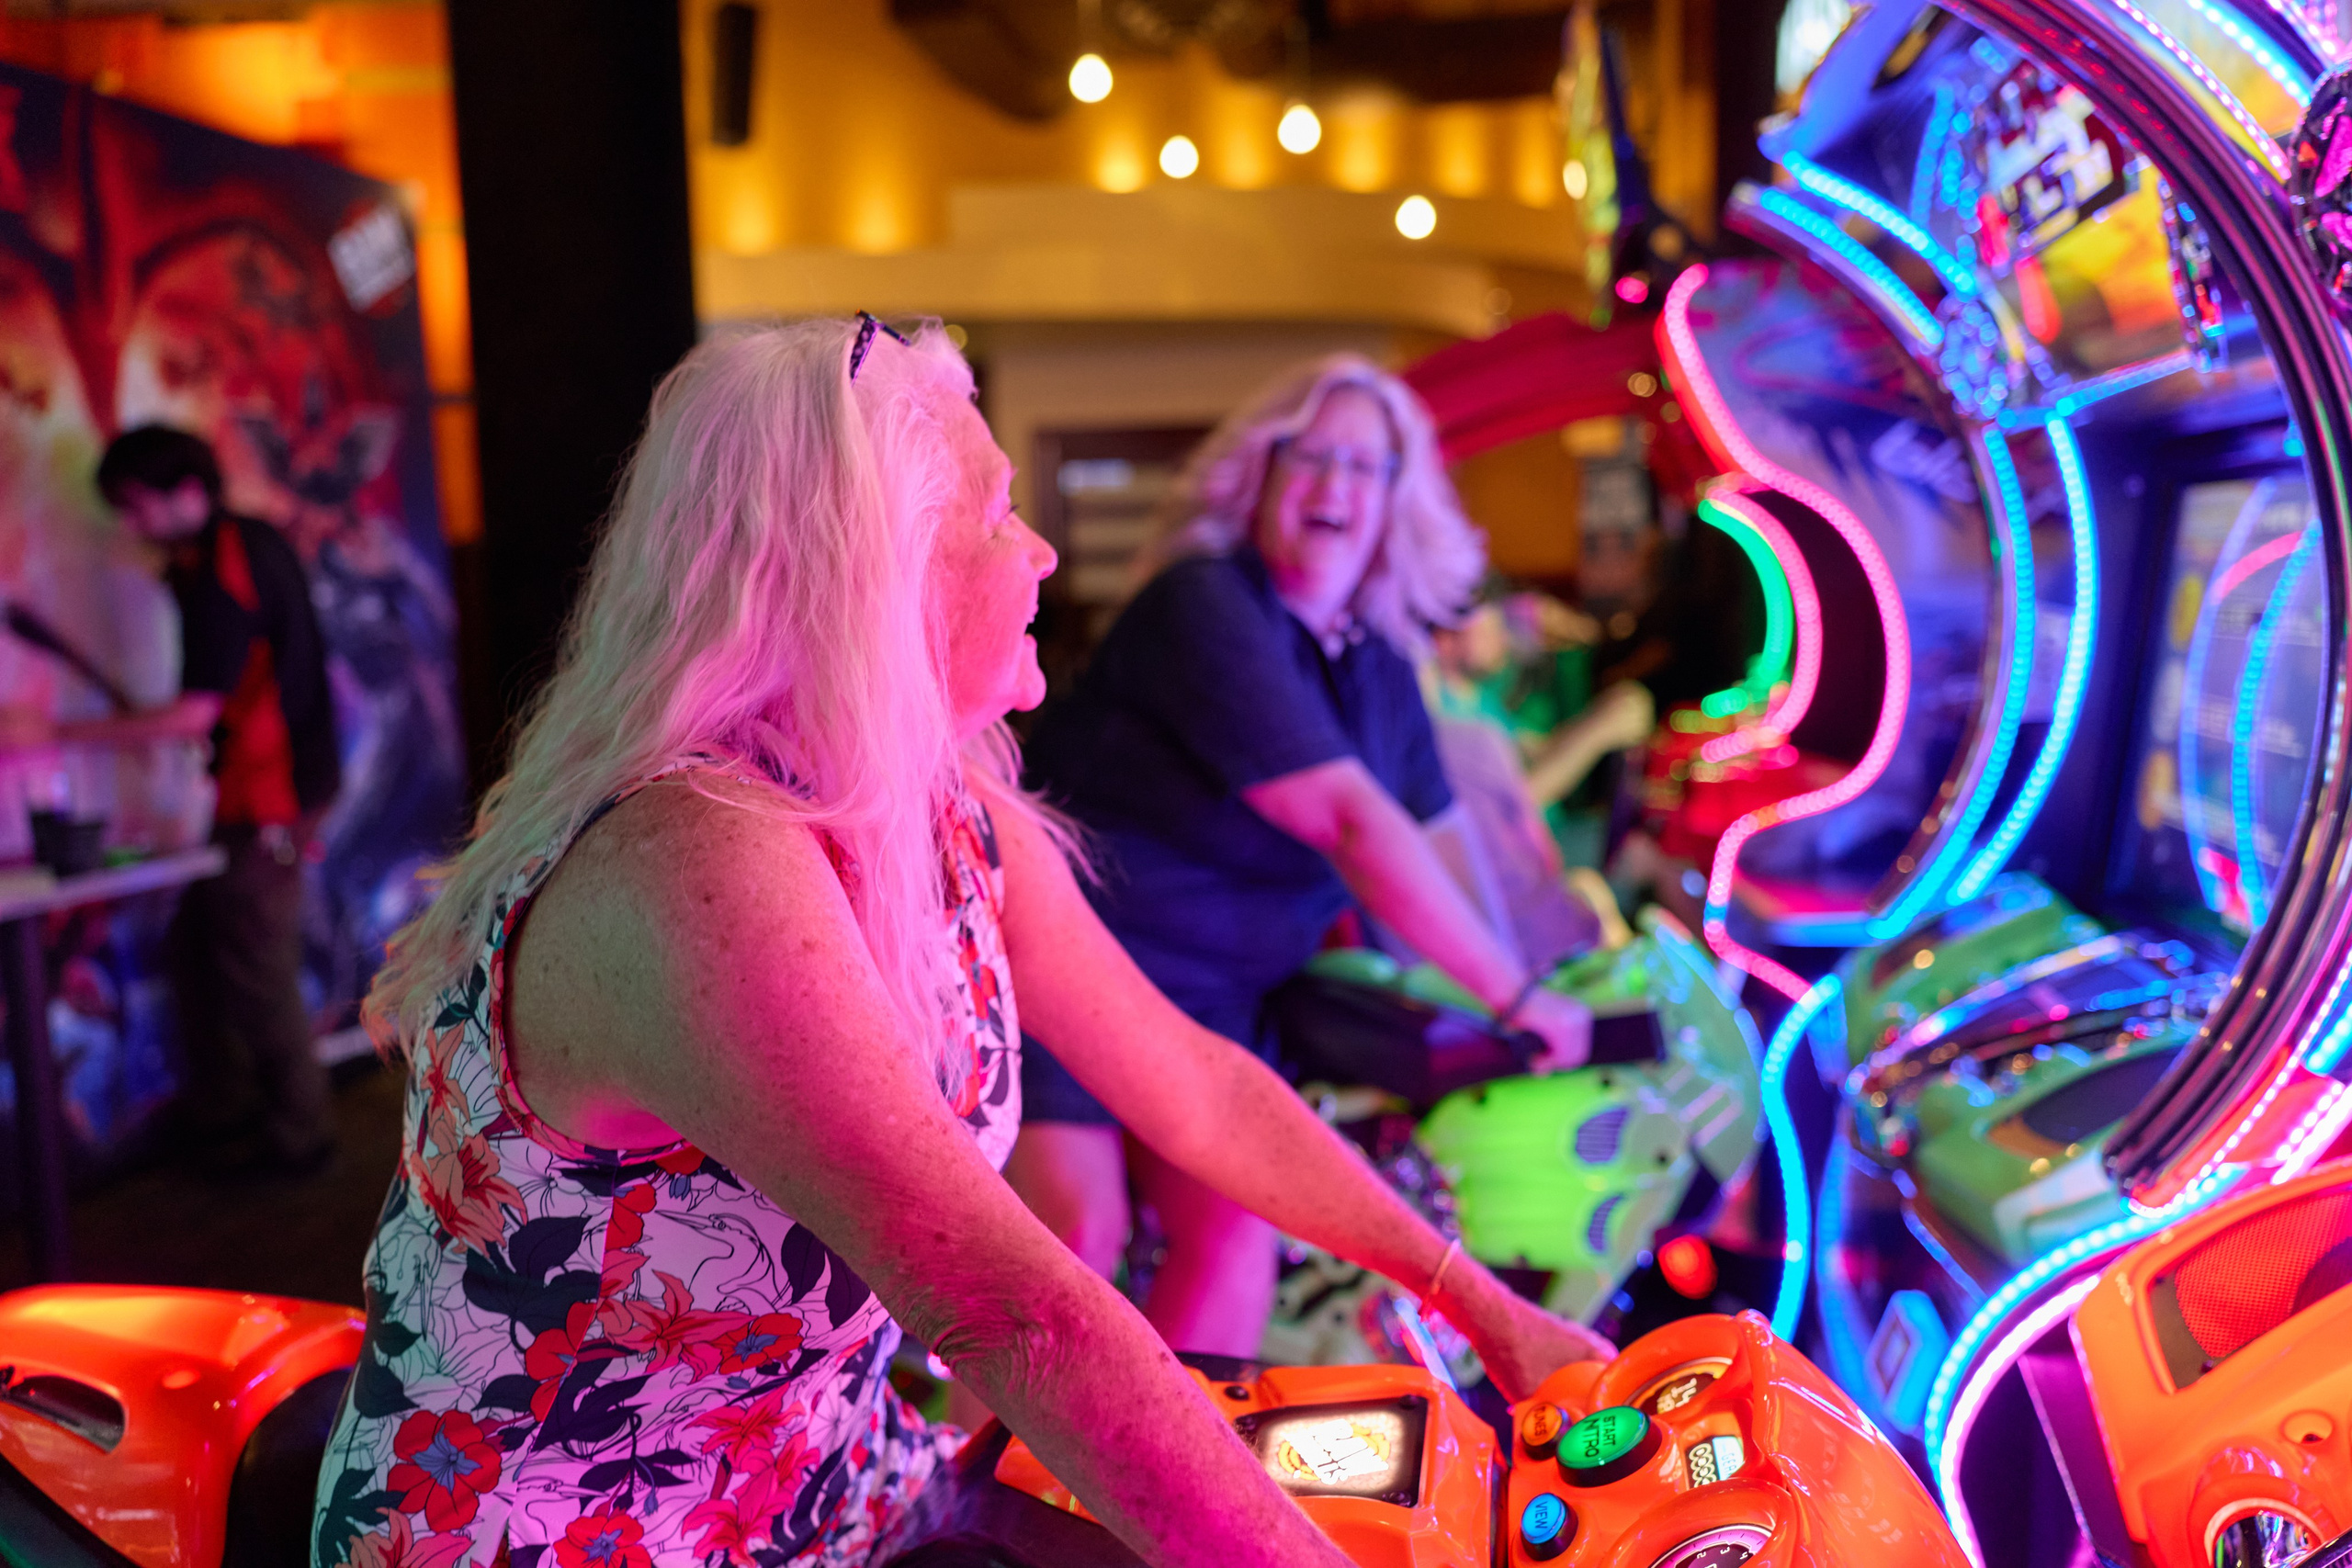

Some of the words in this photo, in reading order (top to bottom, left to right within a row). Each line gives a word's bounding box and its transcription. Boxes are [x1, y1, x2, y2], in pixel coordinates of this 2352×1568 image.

[1533, 1405, 1548, 1437] TUNES
[1603, 1416, 1616, 1446] START
[1582, 1417, 1600, 1458] NITRO
[1534, 1501, 1548, 1529] VIEW
[1720, 1546, 1731, 1555] 3
[1739, 1551, 1748, 1560] 4
